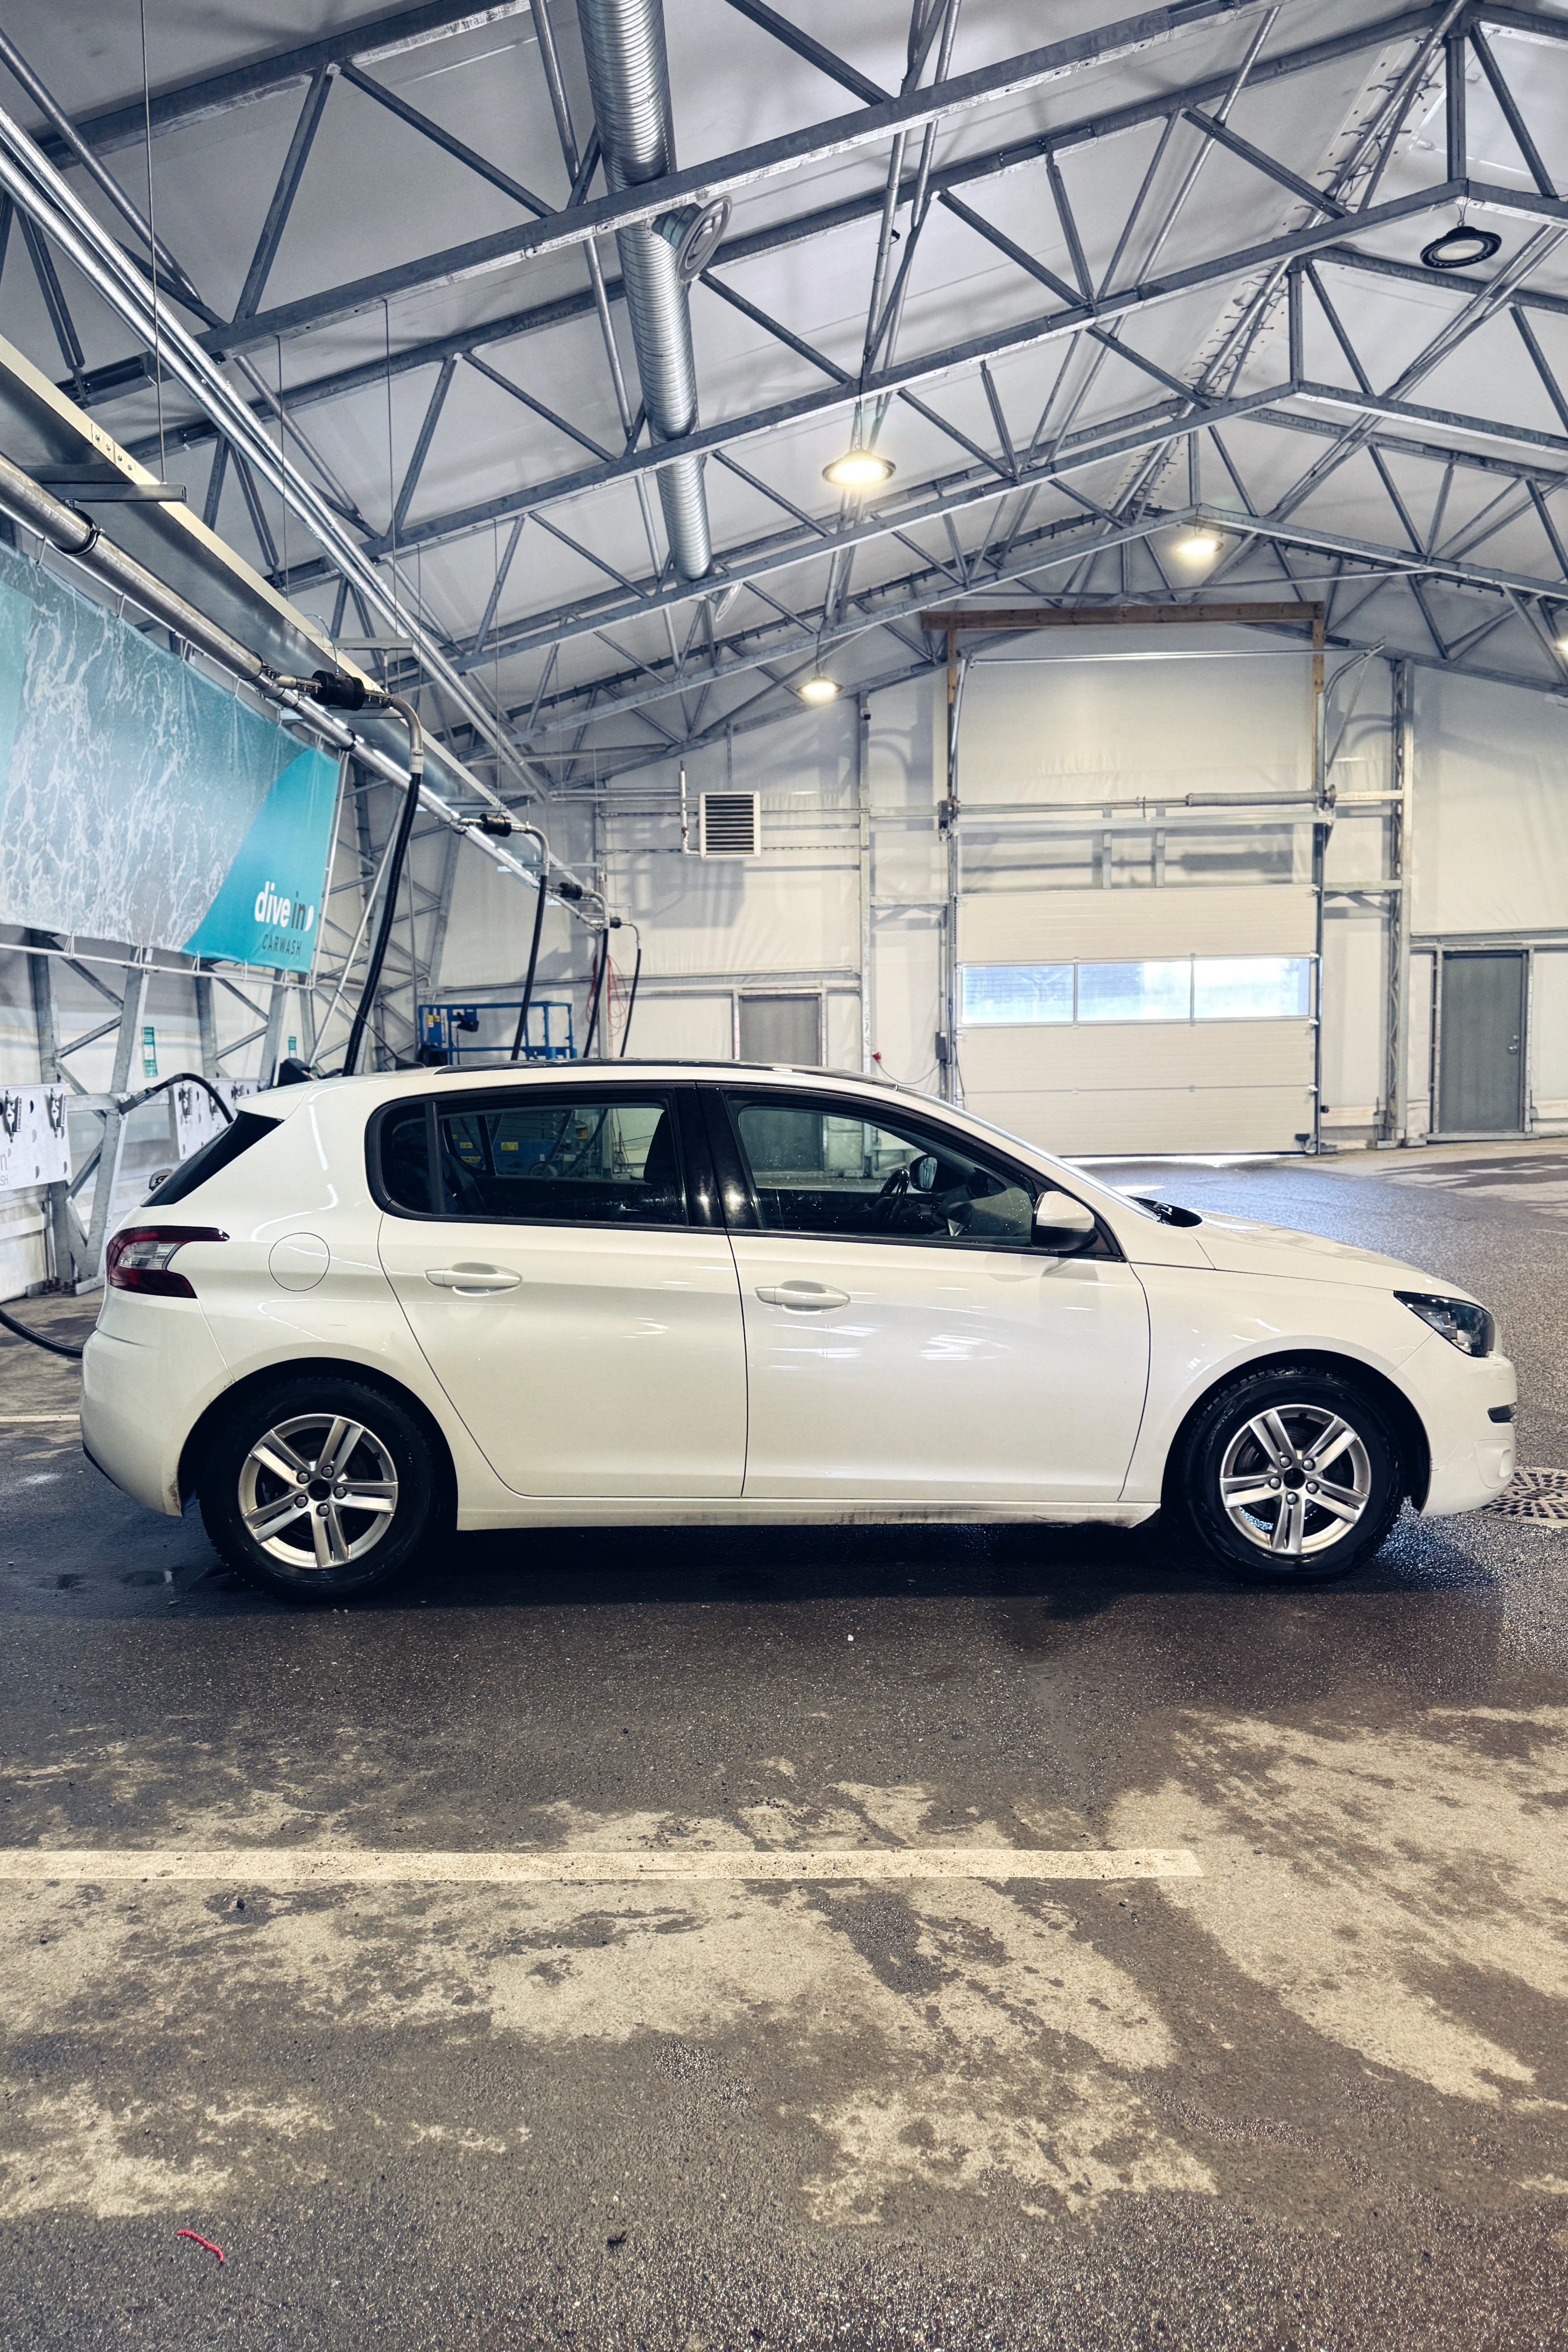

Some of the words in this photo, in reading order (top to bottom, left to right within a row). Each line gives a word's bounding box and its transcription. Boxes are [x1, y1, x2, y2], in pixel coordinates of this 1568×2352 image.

[254, 881, 290, 927] dive
[291, 891, 306, 930] in
[262, 934, 302, 956] CARWASH
